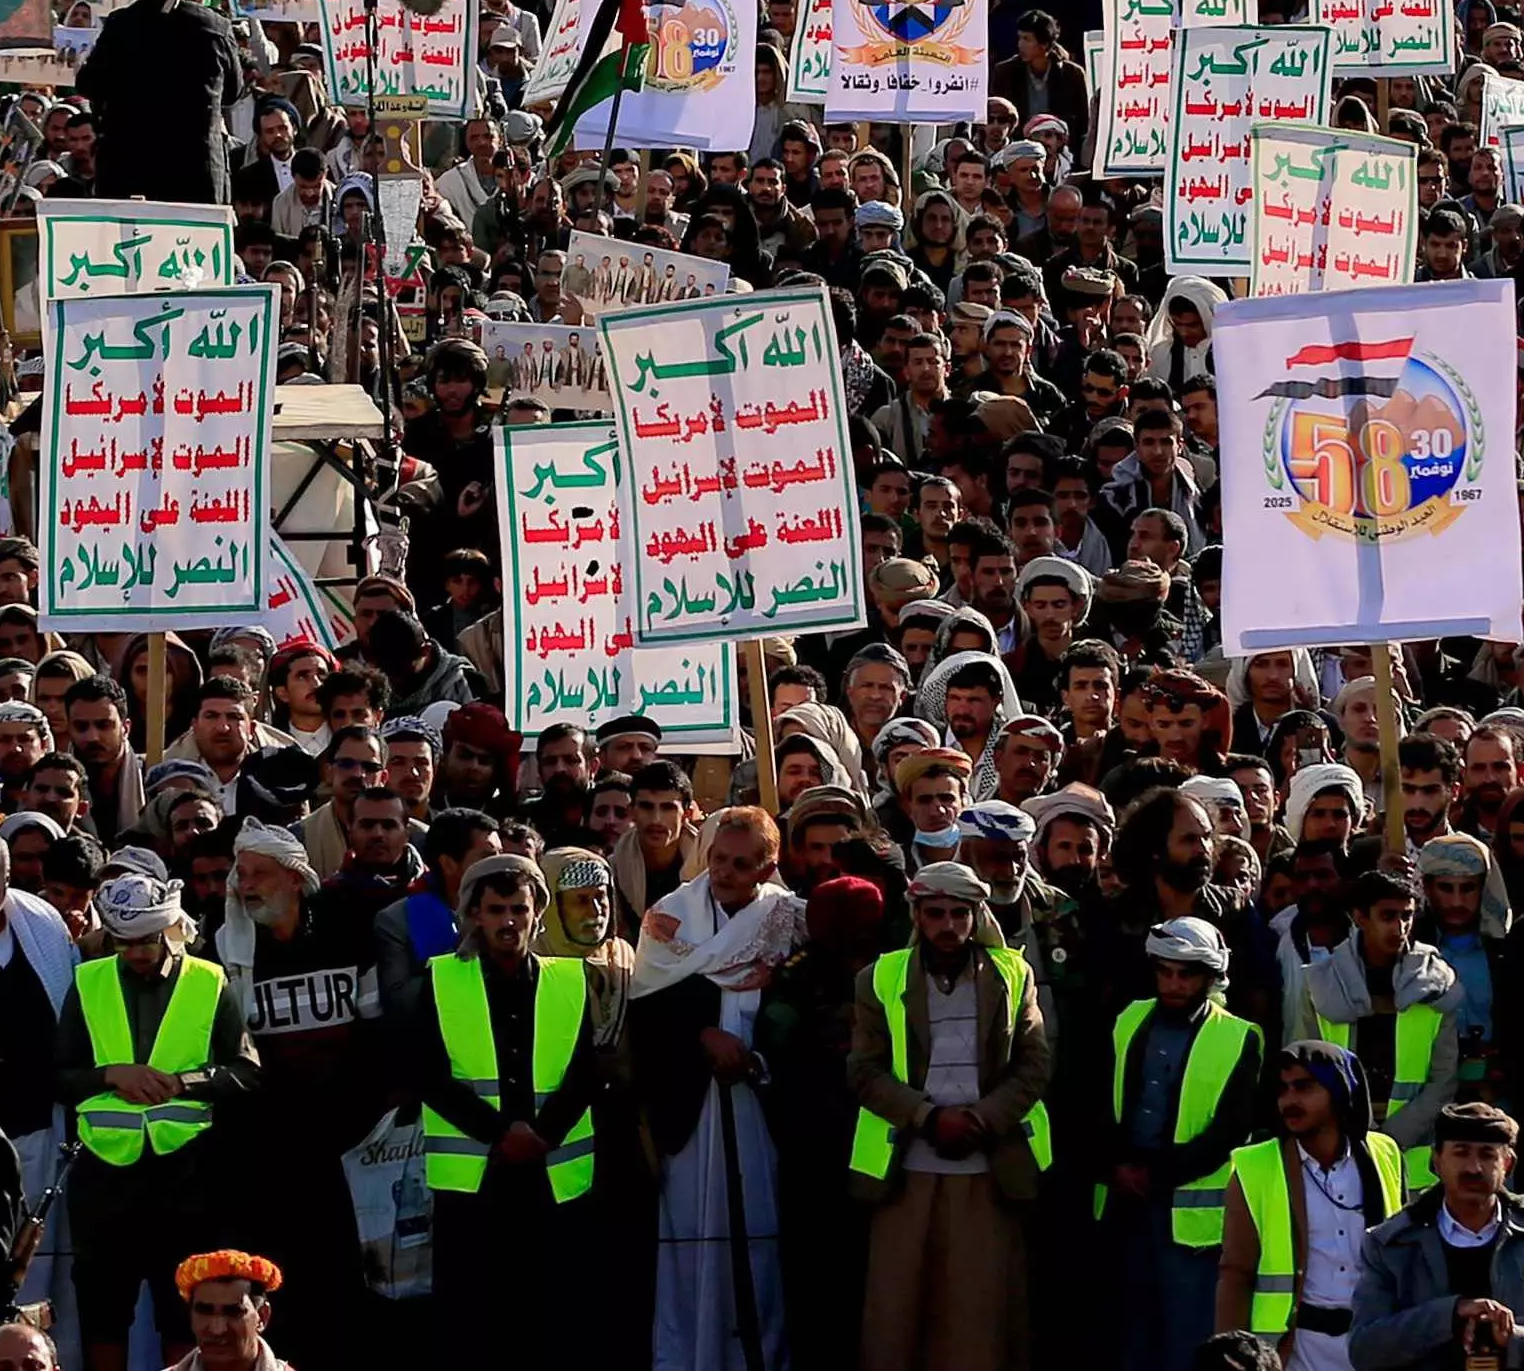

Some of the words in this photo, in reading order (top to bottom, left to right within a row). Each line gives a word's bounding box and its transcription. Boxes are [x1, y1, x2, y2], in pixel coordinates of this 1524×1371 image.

[1322, 0, 1365, 24] اليهود
[1371, 0, 1394, 22] على
[1400, 0, 1437, 18] اللعنة
[871, 47, 910, 62] العامة
[1390, 24, 1438, 58] النصر
[58, 228, 151, 291] أكبر
[68, 302, 184, 376] أكبر
[188, 312, 258, 359] الله
[628, 307, 764, 396] أكبر
[764, 313, 821, 366] الله
[65, 373, 165, 423] لأمريكا
[173, 382, 252, 422] الموت
[633, 394, 725, 444] لأمريكا
[735, 390, 828, 435] الموت
[62, 437, 164, 478] لإسرائيل
[172, 437, 250, 478] الموت
[519, 430, 621, 505] أكبر
[742, 448, 836, 494] الموت
[1289, 411, 1411, 517] 58
[1410, 429, 1452, 459] 30
[1410, 461, 1453, 479] نوفمبر
[642, 459, 738, 506] لإسرائيل
[1264, 498, 1292, 508] 2025
[1455, 490, 1482, 500] 1967
[60, 492, 131, 533] اليهود
[140, 492, 180, 533] على
[190, 490, 249, 524] اللعنة
[522, 500, 620, 550] لأمريكا
[776, 507, 842, 545] اللعنة
[1412, 505, 1436, 525] العيد
[646, 522, 718, 564] اليهود
[723, 517, 768, 560] على
[1368, 520, 1409, 541] الوطني
[60, 544, 156, 602] للإسلام
[165, 537, 249, 598] النصر
[764, 560, 846, 619] النصر
[647, 571, 754, 630] للإسلام
[526, 617, 595, 660] اليهود
[527, 668, 621, 723] للإسلام
[633, 660, 716, 717] النصر
